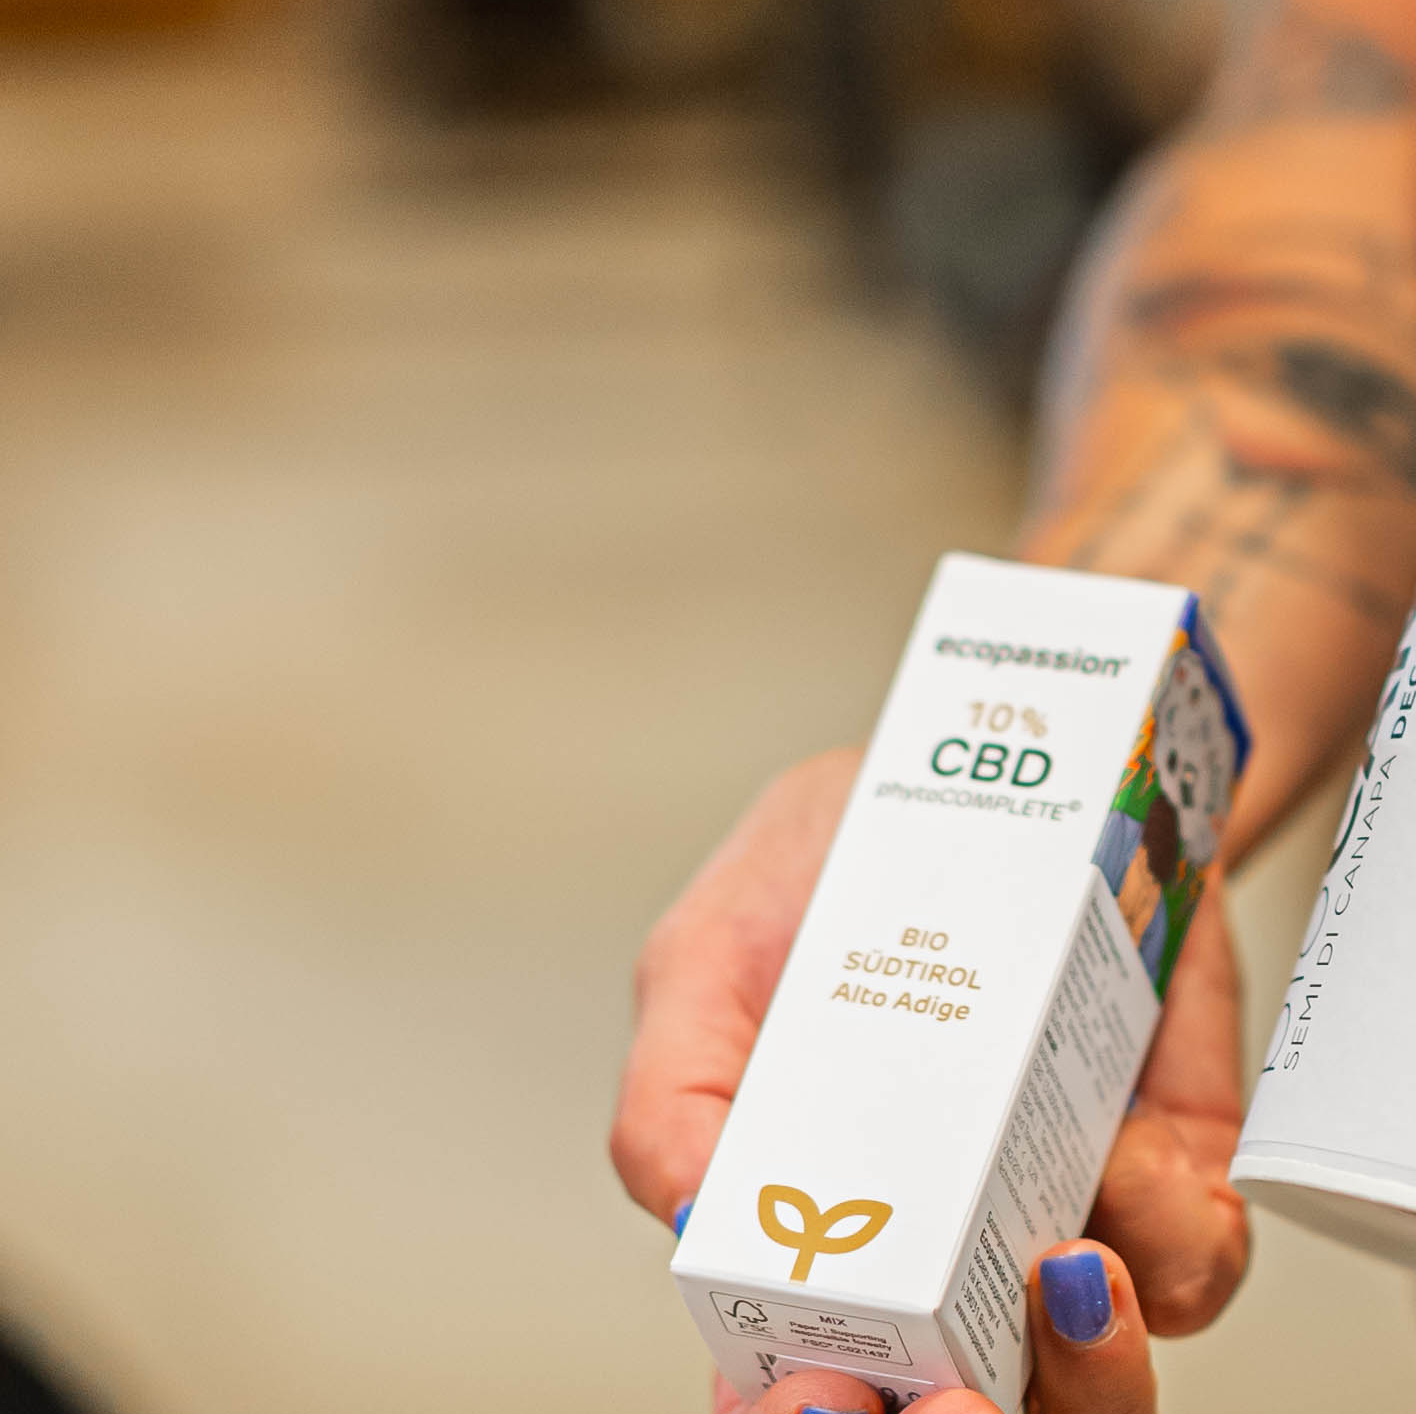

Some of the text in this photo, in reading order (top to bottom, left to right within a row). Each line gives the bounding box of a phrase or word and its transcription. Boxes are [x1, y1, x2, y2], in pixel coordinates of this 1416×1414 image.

[930, 737, 1054, 789] CBD
[1283, 983, 1323, 1071] SEMI
[1316, 932, 1339, 966] DI
[1334, 754, 1397, 916] CANAPA
[901, 926, 950, 952] BIO
[843, 948, 982, 991] SÜDTIROL
[831, 981, 971, 1022] Alto Adige
[980, 1228, 1009, 1284] Ecopassion
[819, 1315, 848, 1327] MIX
